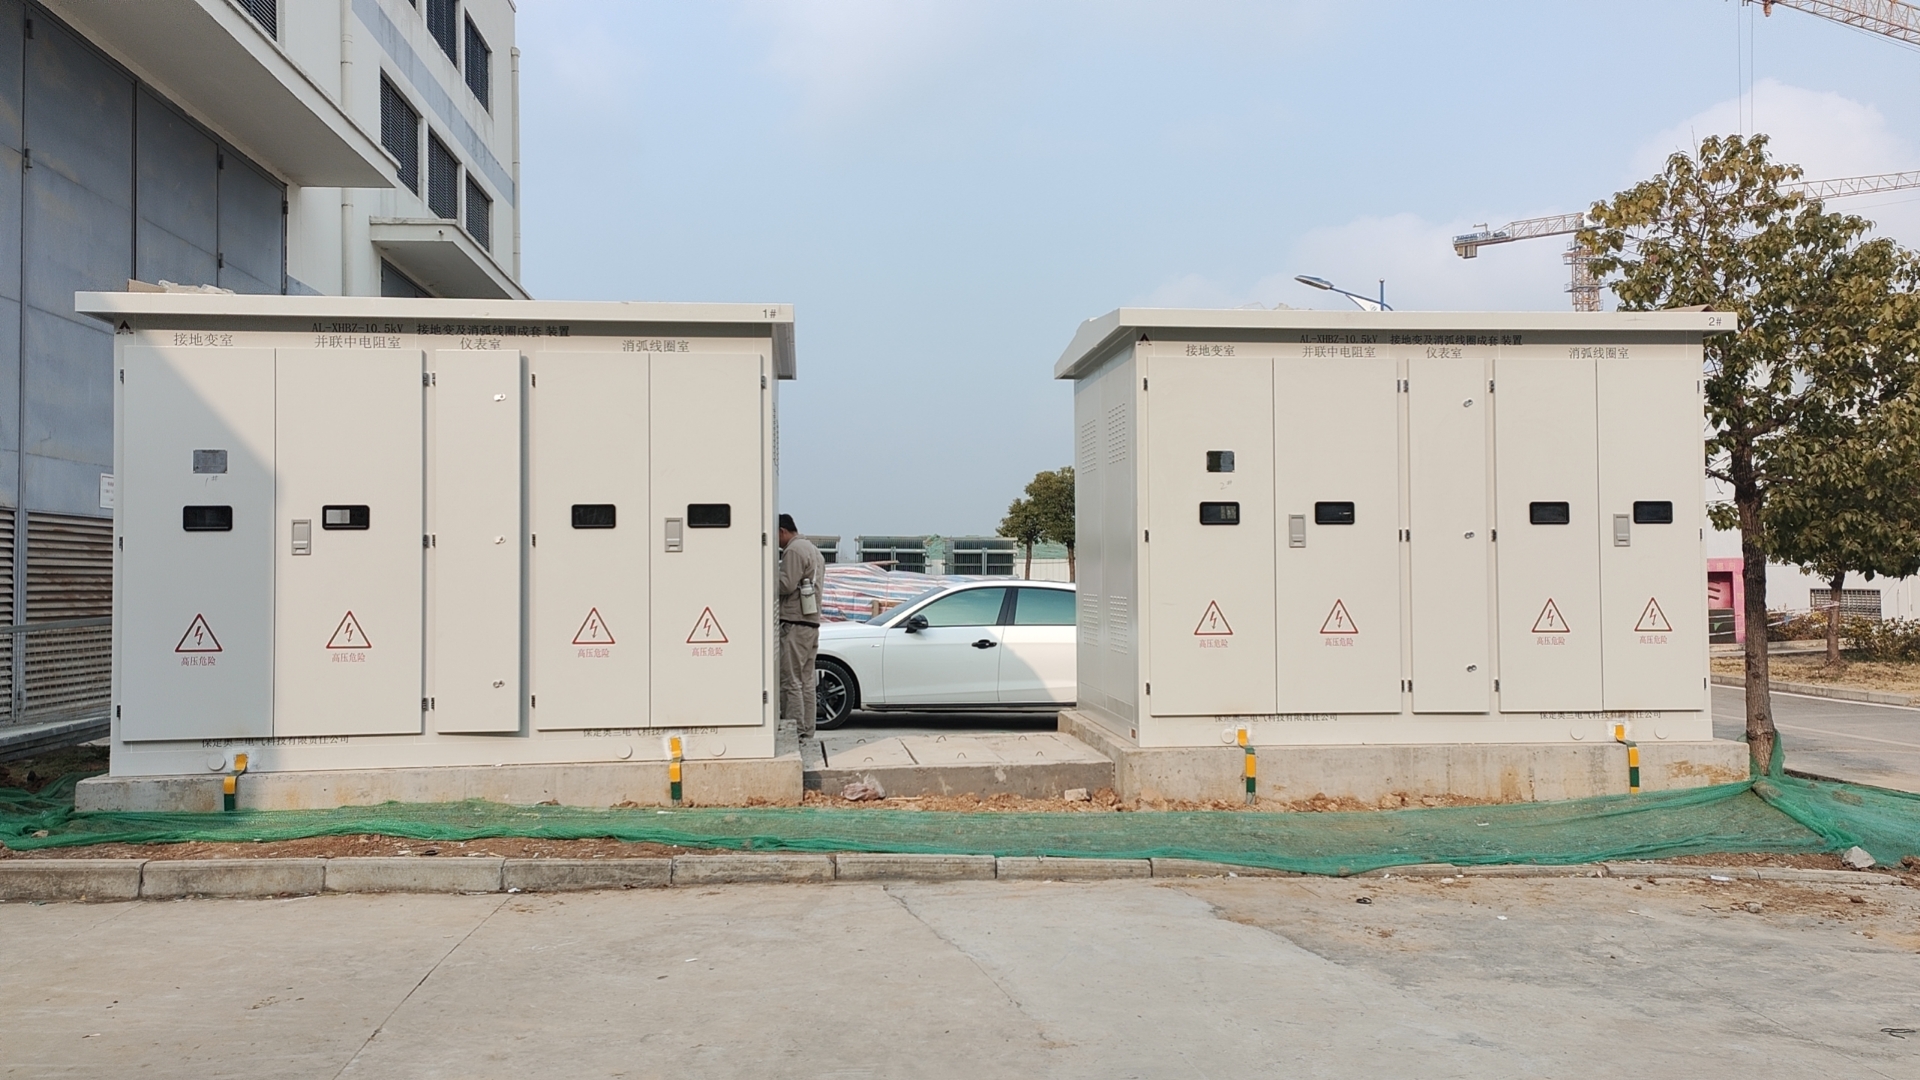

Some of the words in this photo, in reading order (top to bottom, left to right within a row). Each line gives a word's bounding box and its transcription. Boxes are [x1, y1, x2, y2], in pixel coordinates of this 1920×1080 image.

[762, 308, 777, 319] 1#
[1708, 317, 1722, 327] 2#
[312, 322, 404, 334] AL-XHBZ-10.5kV
[416, 323, 542, 338] 接地变及消弧线圈成套
[546, 325, 570, 338] 装置
[173, 333, 234, 347] 接地变室
[314, 335, 402, 350] 并联中电阻室
[460, 337, 502, 351] 仪表室
[1300, 334, 1378, 345] AL-XHBZ-10.5kV
[1390, 334, 1499, 346] 接地变及消弧线圈成套
[1501, 335, 1523, 346] 装置
[622, 339, 690, 353] 消弧线圈室
[1185, 344, 1236, 358] 接地变室
[1302, 346, 1376, 359] 并联中电阻室
[1426, 347, 1463, 360] 仪表室
[1568, 347, 1630, 360] 消弧线圈室
[1199, 639, 1228, 649] 高压危险
[1325, 637, 1354, 647] 高压危险
[1536, 636, 1566, 646] 高压危险
[1639, 635, 1668, 645] 高压危险
[332, 652, 366, 663] 高压危险
[577, 648, 610, 658] 高压危险
[691, 647, 724, 657] 高压危险
[180, 656, 216, 667] 高压危险
